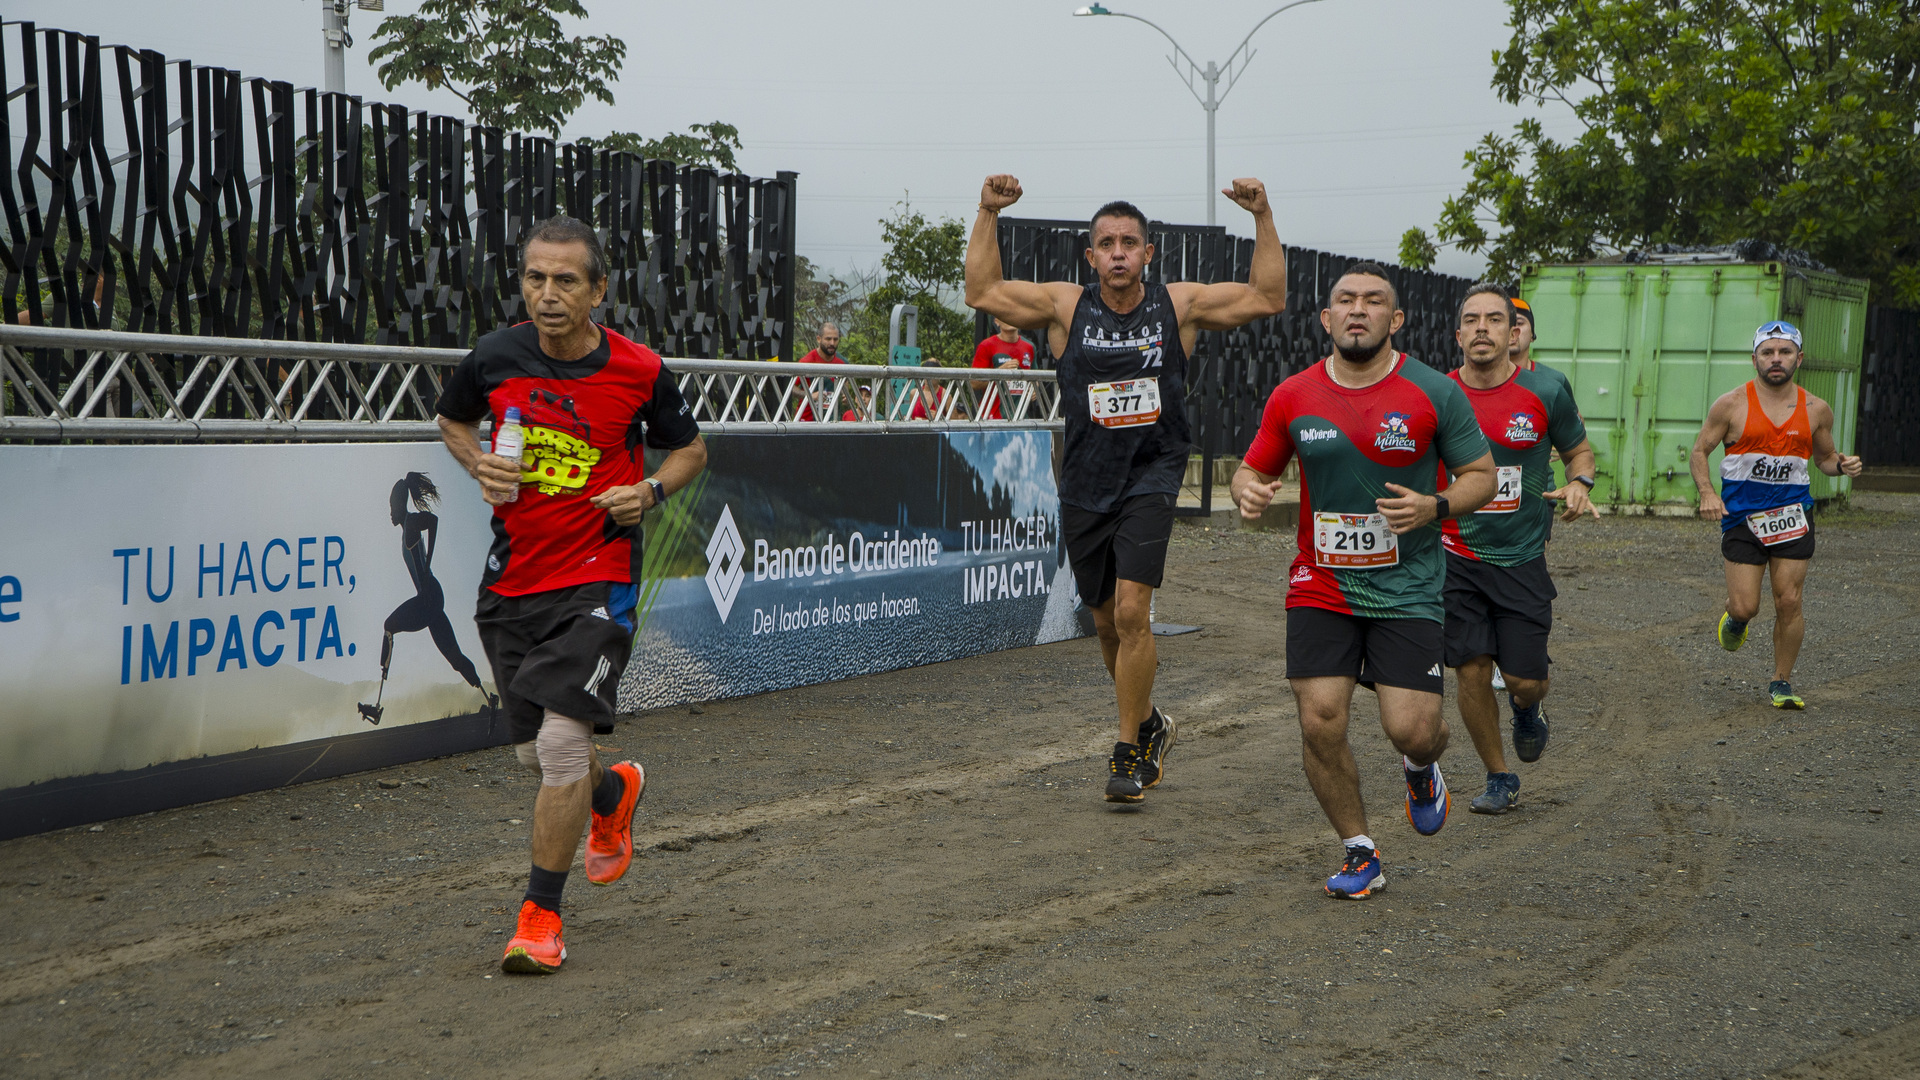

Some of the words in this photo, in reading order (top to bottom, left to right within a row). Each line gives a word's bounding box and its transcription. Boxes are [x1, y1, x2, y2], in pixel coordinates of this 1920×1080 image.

[1084, 322, 1163, 341] CARLOS
[1142, 346, 1163, 369] 72
[1107, 394, 1141, 413] 377
[522, 426, 602, 466] ARRERA
[533, 446, 562, 460] DEL
[1373, 435, 1416, 449] Muñeca
[1751, 464, 1788, 479] GWR
[961, 520, 984, 557] TU
[990, 515, 1051, 554] HACER,
[1760, 517, 1796, 534] 1600
[1335, 531, 1376, 551] 219
[753, 538, 816, 583] Banco
[821, 533, 844, 575] de
[848, 529, 939, 574] Occidente
[113, 546, 175, 606] TU
[198, 535, 357, 598] HACER,
[963, 560, 1051, 605] IMPACTA.
[752, 604, 777, 636] Del
[779, 600, 810, 632] lado
[812, 597, 829, 627] de
[832, 595, 851, 624] los
[854, 601, 878, 628] que
[880, 592, 921, 619] hacen.
[120, 605, 357, 685] IMPACTA.
